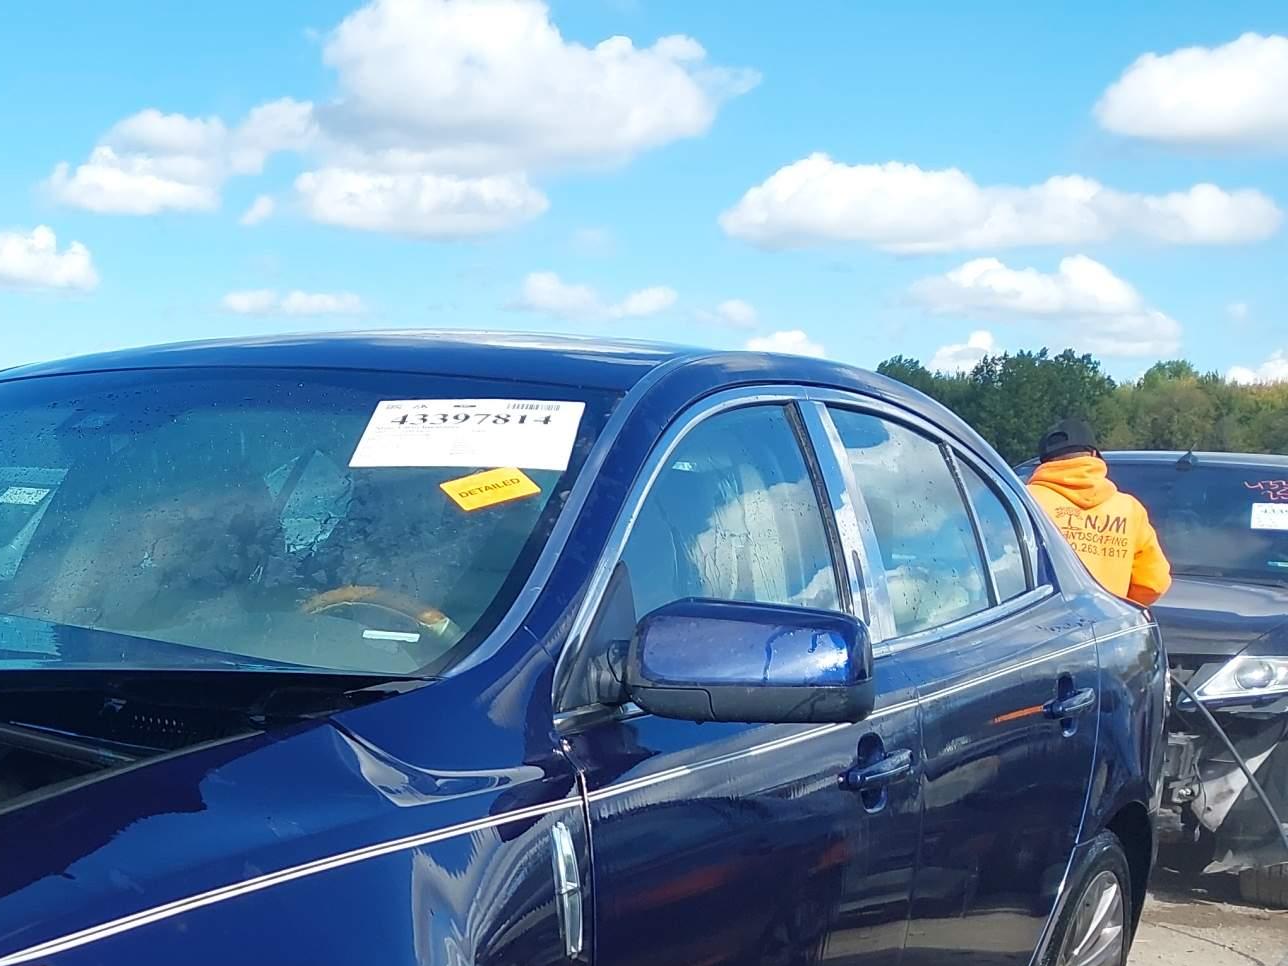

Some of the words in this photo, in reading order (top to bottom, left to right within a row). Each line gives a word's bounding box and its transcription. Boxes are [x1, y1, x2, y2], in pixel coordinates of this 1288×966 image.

[391, 413, 552, 425] 43397814
[458, 478, 521, 498] DETAILED
[1084, 514, 1127, 535] NJM
[1063, 530, 1128, 547] ANDSCAPING
[1070, 542, 1128, 559] 0.263.1817
